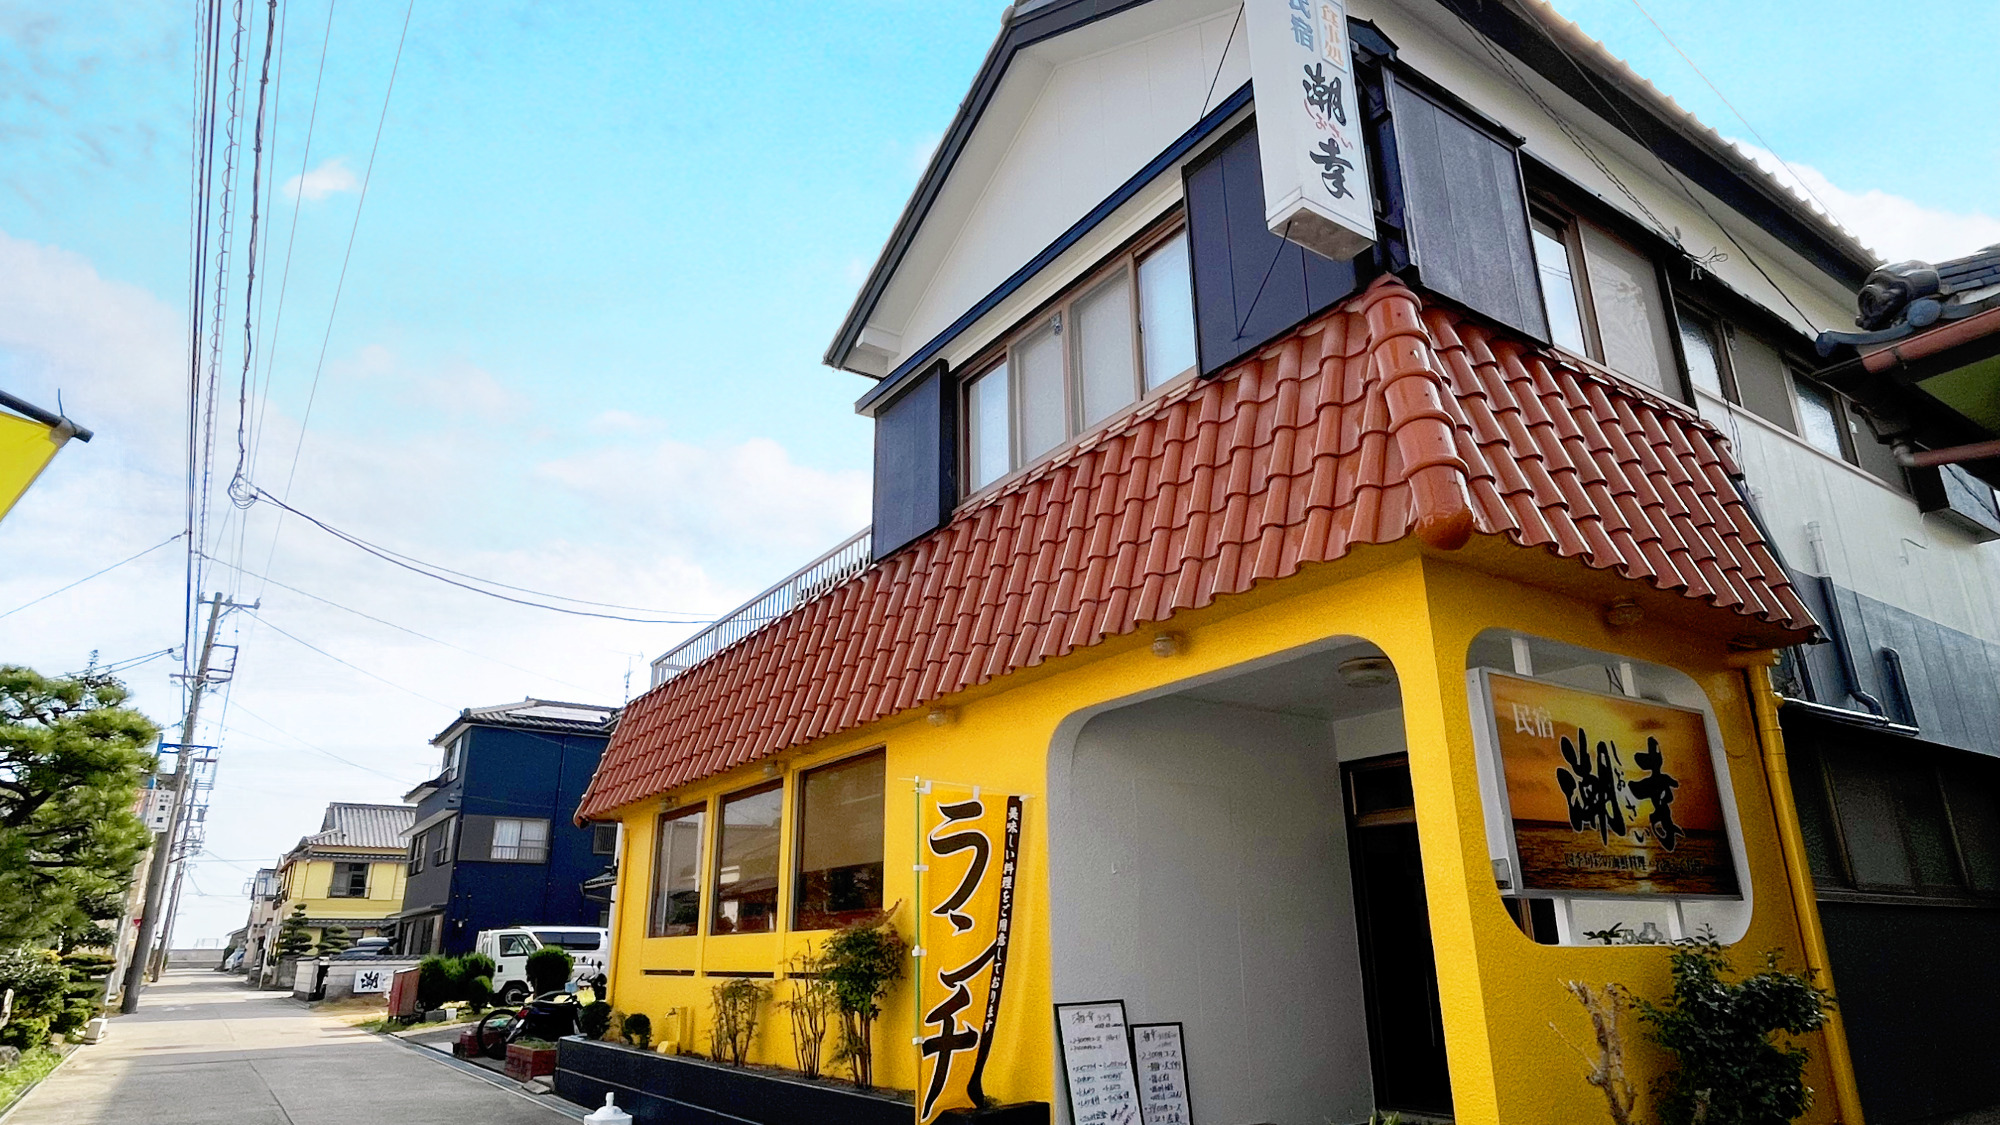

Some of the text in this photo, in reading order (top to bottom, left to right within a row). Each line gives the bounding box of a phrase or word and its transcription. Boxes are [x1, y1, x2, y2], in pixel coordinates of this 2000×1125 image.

[1303, 62, 1355, 200] 潮幸
[1511, 702, 1555, 739] 民宿
[1556, 727, 1686, 852] 潮幸
[1610, 740, 1650, 843] しおさい
[922, 800, 997, 1122] ランチ
[984, 806, 1019, 1034] 美味しい料理をご用意しております
